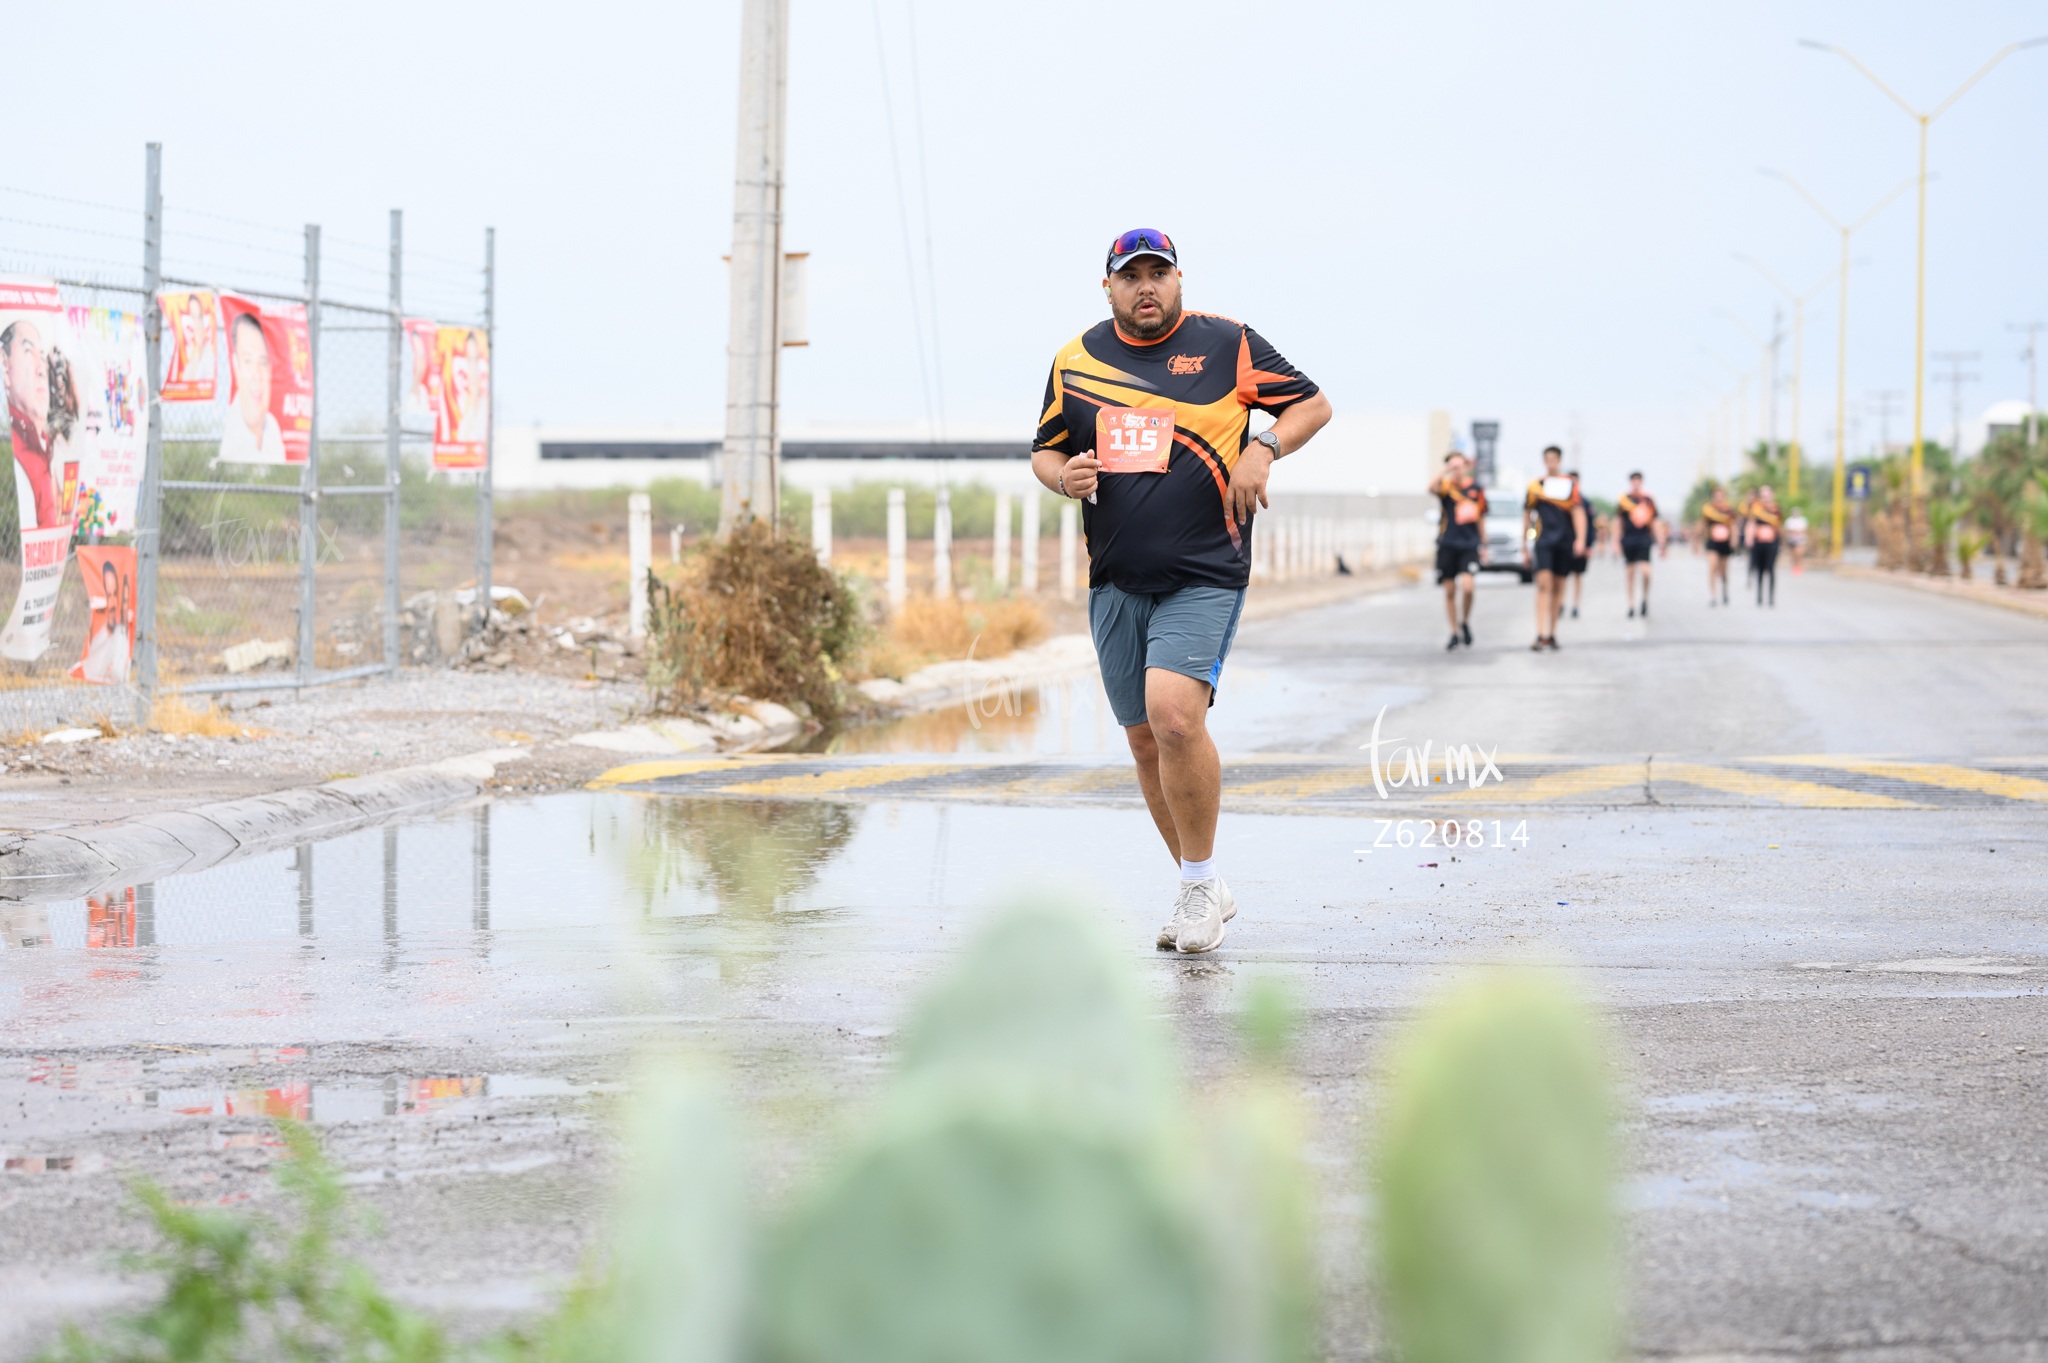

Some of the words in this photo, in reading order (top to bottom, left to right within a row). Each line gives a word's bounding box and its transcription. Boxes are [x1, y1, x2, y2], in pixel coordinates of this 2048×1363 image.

[1110, 428, 1158, 452] 115
[63, 479, 77, 510] PT
[24, 540, 55, 568] RICARDO
